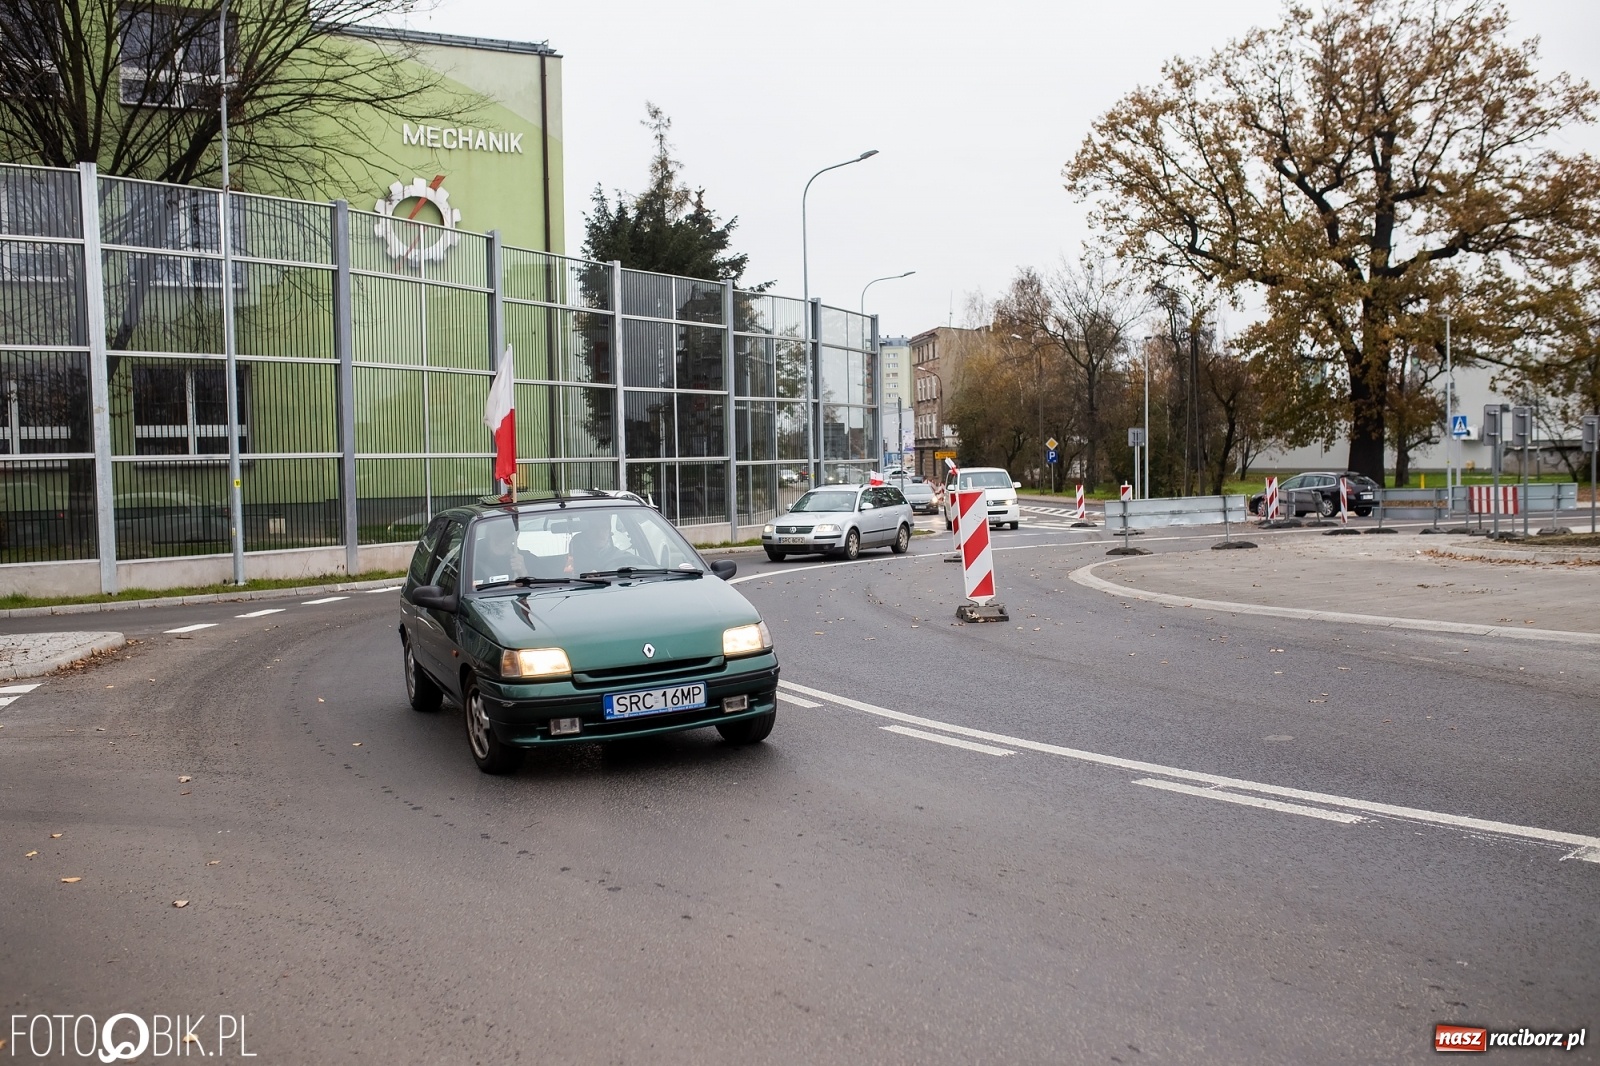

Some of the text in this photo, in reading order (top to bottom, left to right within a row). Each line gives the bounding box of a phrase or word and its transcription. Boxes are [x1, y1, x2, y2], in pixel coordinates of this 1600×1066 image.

[402, 123, 524, 154] MECHANIK
[1049, 451, 1056, 460] P
[616, 692, 654, 714] SRC
[661, 686, 702, 708] 16MP
